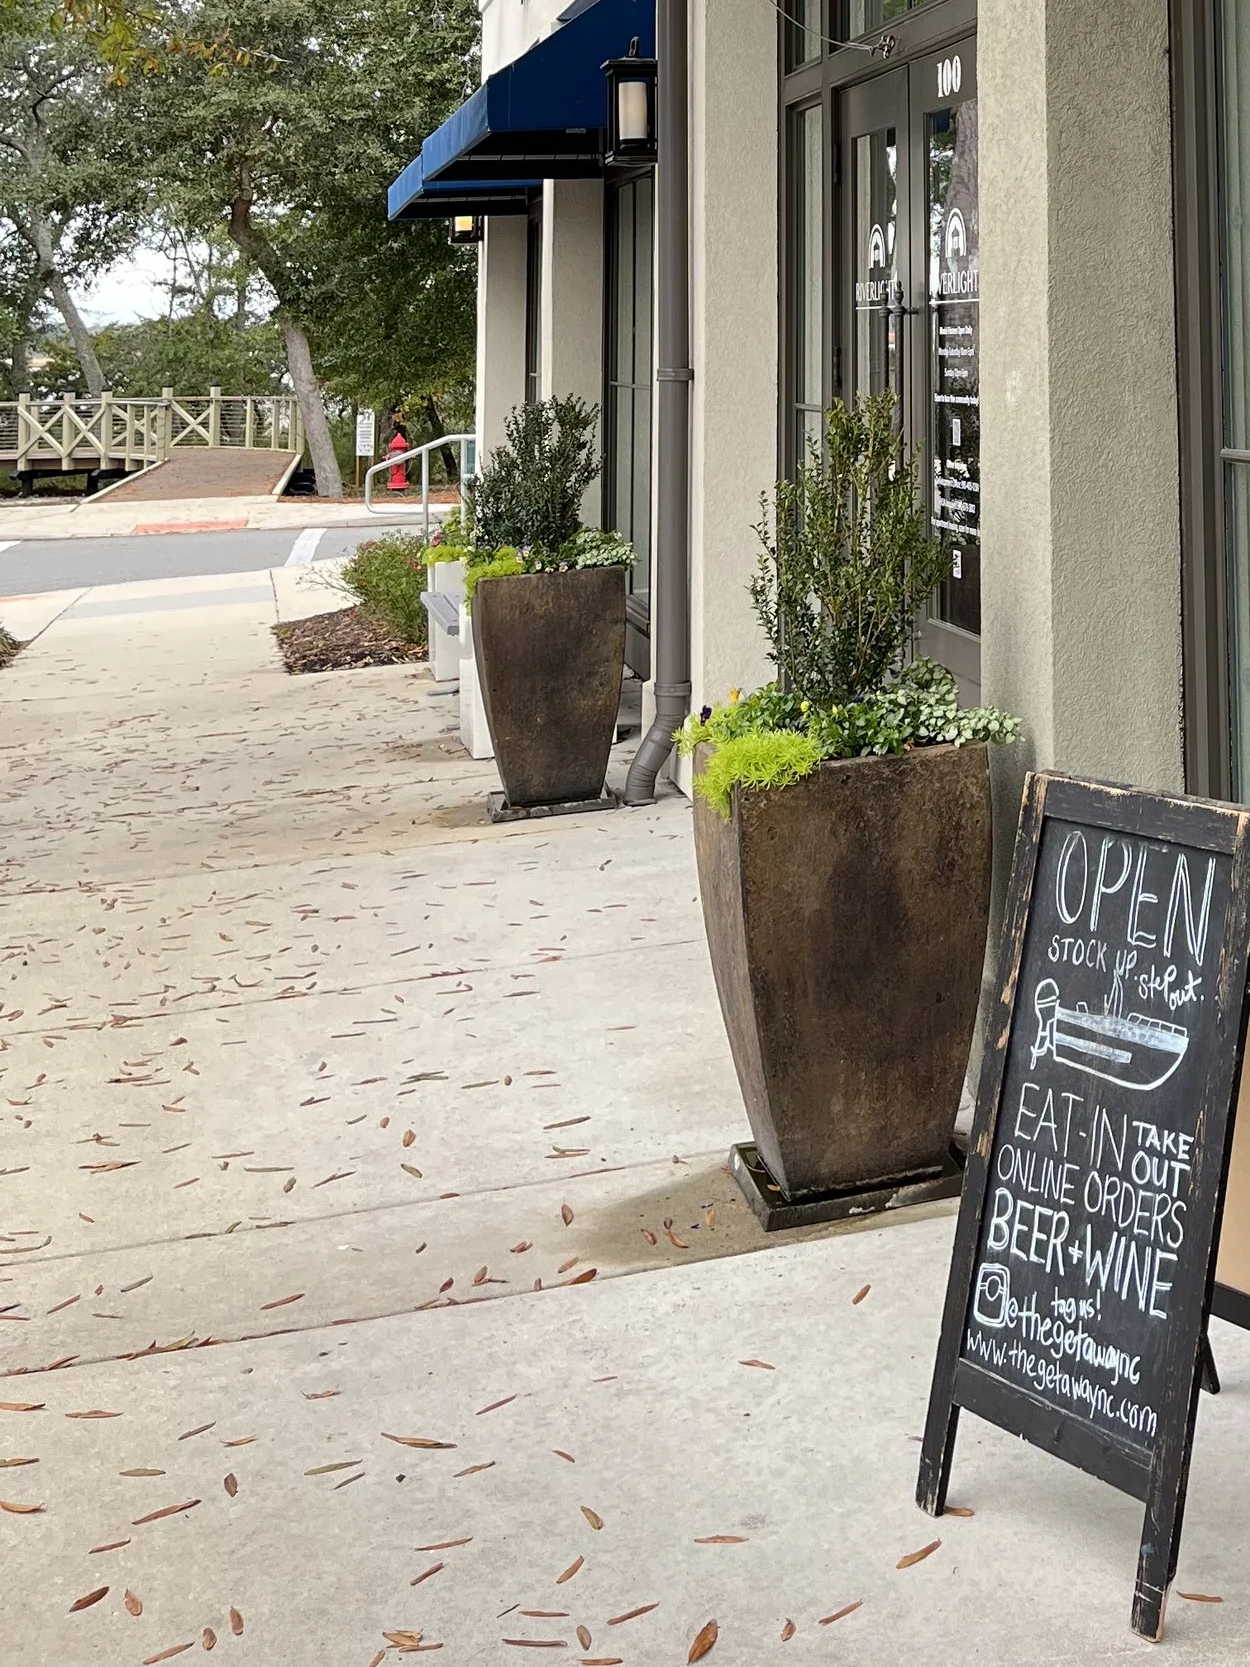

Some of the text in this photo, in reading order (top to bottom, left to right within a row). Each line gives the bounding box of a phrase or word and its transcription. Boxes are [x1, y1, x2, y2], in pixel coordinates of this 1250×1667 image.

[937, 55, 961, 97] 100
[1056, 831, 1215, 966] OPEN
[1047, 934, 1106, 972] STOCK
[1133, 1120, 1194, 1160] TAKE
[1131, 1150, 1190, 1197] OUT
[998, 1144, 1187, 1248] ONLINE ORDERS
[1051, 1286, 1076, 1322] tag
